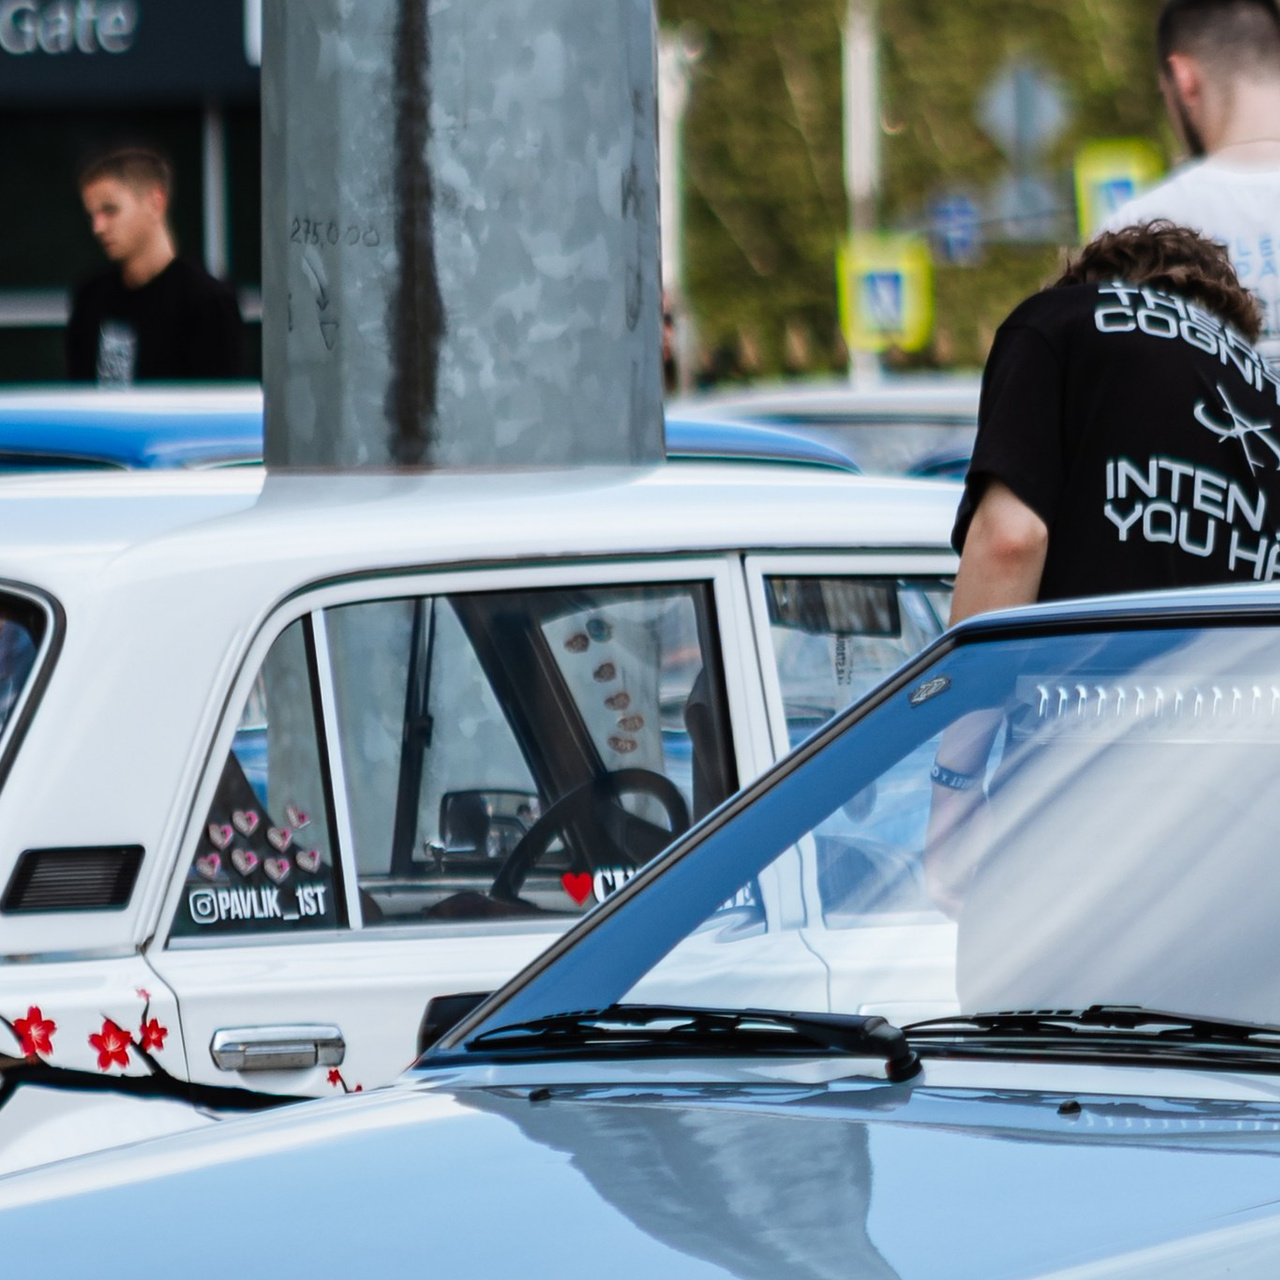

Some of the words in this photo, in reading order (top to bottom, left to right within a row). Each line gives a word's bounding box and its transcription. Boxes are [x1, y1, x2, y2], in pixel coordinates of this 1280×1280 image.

[1106, 458, 1266, 532] INTEN
[1104, 501, 1216, 558] YOU
[217, 884, 327, 921] PAVLIK_1ST
